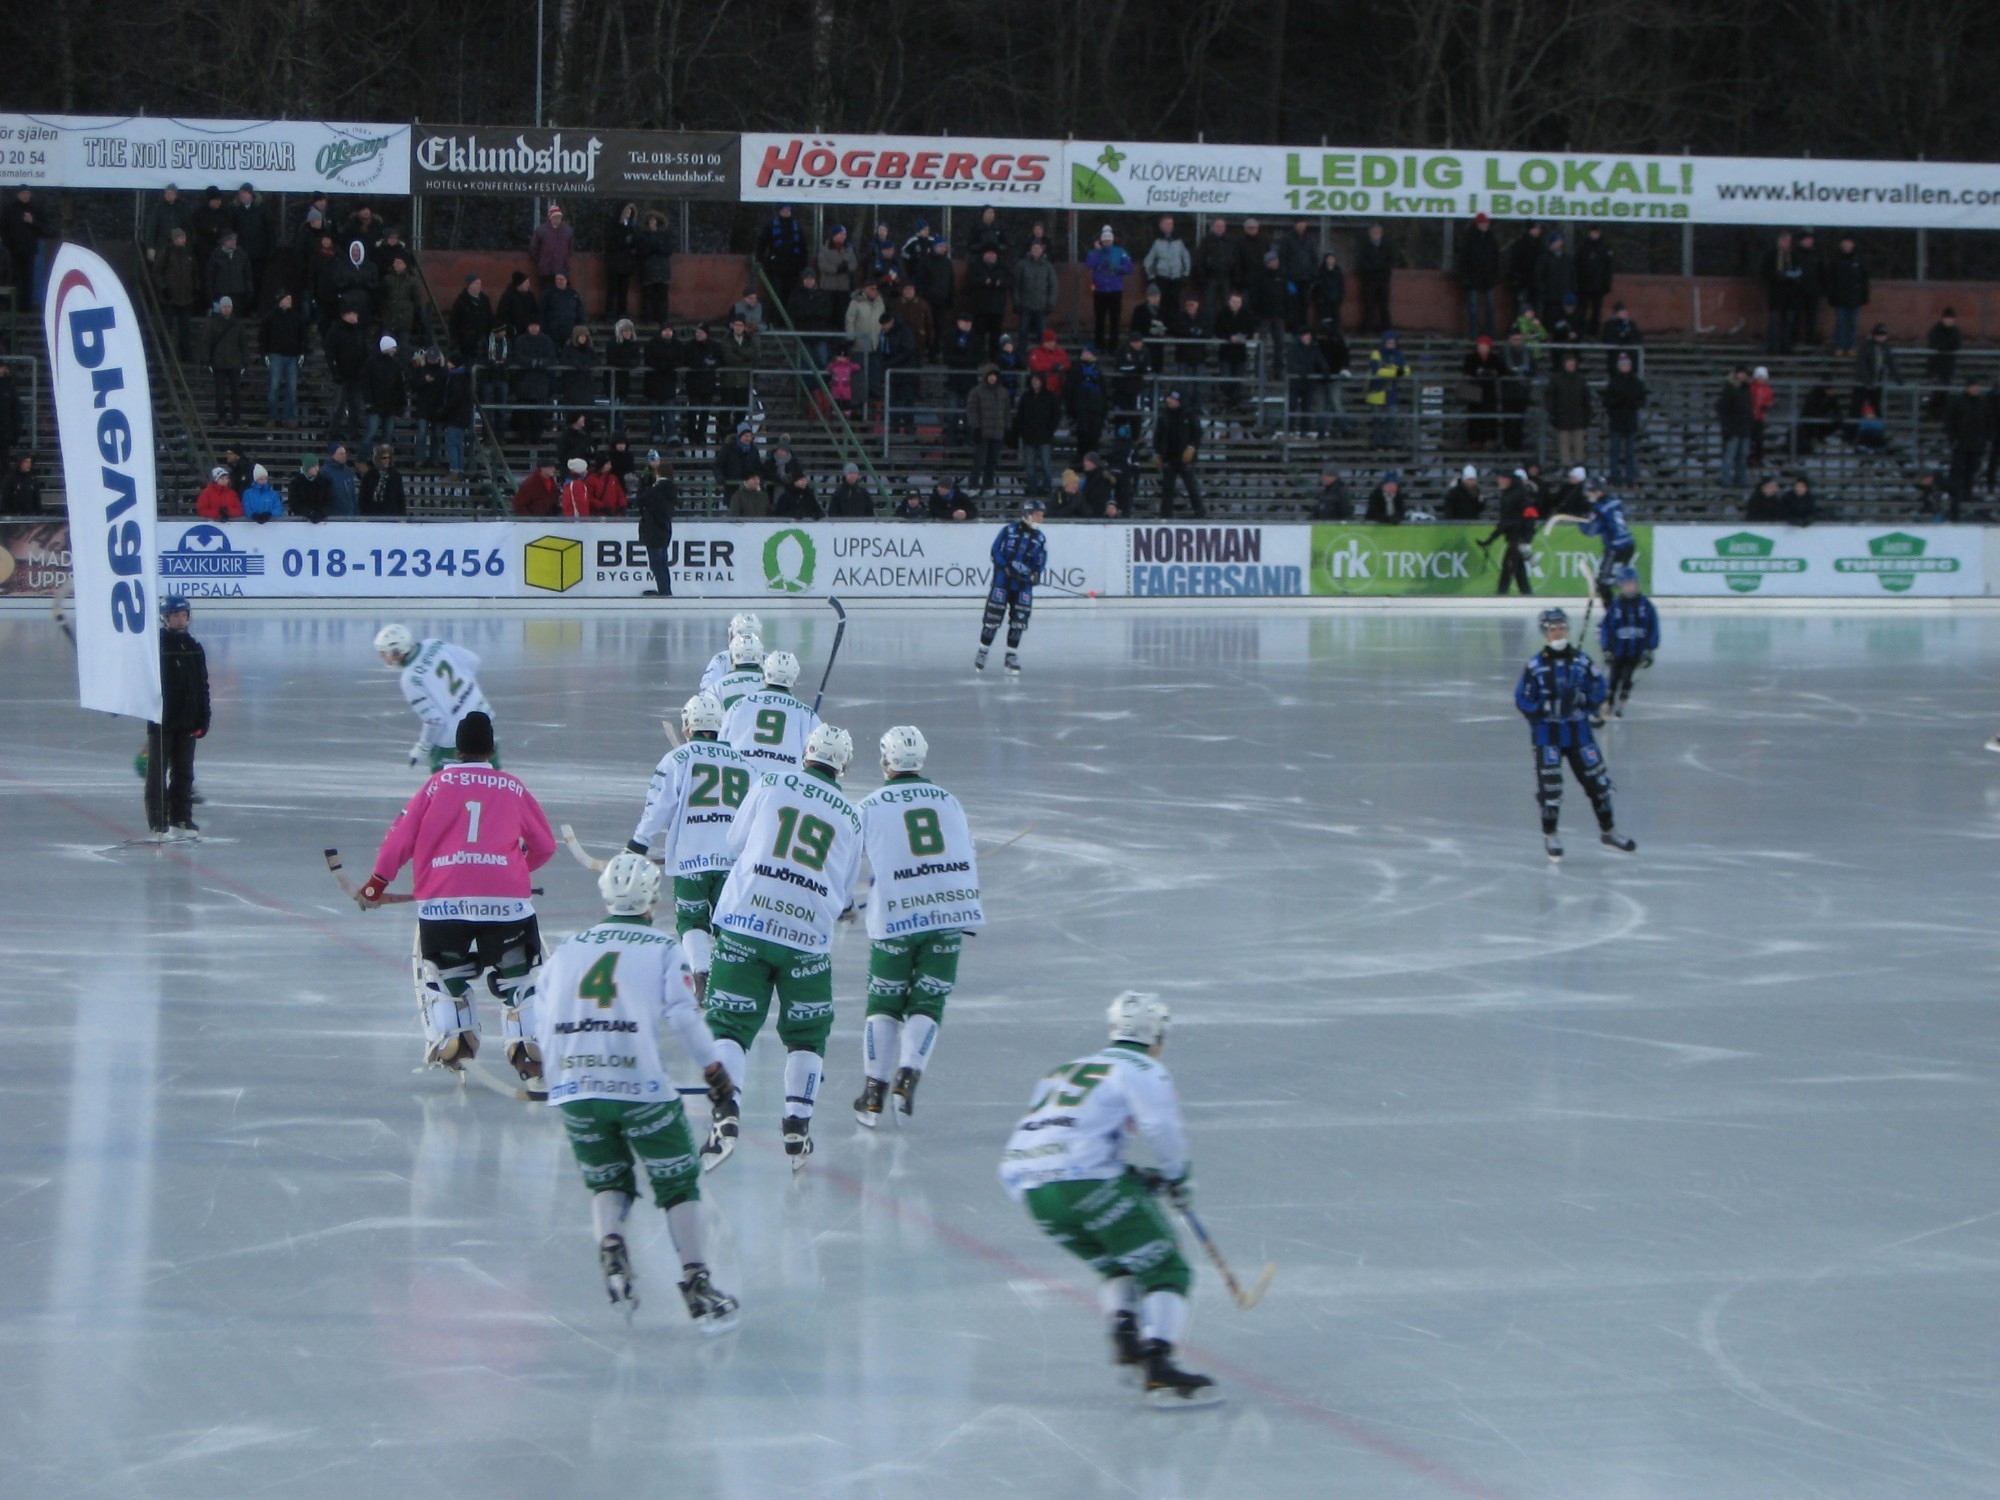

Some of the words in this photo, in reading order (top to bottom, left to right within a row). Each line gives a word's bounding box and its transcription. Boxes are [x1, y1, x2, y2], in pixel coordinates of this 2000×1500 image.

[17, 127, 59, 143] själen
[9, 150, 25, 164] 20
[30, 151, 46, 165] 54
[84, 137, 127, 168] THE
[171, 140, 296, 172] SPORTSBAR
[416, 132, 604, 182] Eklundshof
[628, 151, 649, 164] Tel.
[651, 152, 688, 165] 018-55
[690, 153, 704, 165] 01
[707, 154, 721, 165] 00
[756, 139, 1049, 188] HÖGBERGS
[623, 170, 726, 183] www.eklundshof.se
[1129, 160, 1262, 183] KLÖVERVALLEN
[1286, 153, 1463, 189] LEDIG
[1486, 158, 1694, 195] LOKAL!
[425, 180, 463, 190] HOTELL
[470, 181, 528, 192] KONFERENS
[534, 181, 595, 193] FESTVÅNING
[776, 177, 852, 189] BUSS
[862, 180, 902, 191] AB
[913, 181, 1041, 193] UPPSALA
[1146, 185, 1230, 206] fastigheter
[1285, 189, 1371, 211] 1200
[1383, 191, 1455, 214] kvm
[1490, 193, 1689, 219] Boländerna
[596, 540, 735, 567] BEJER
[833, 537, 925, 558] UPPSALA
[1133, 527, 1262, 564] NORMAN
[166, 557, 243, 573] TAXIKURIR
[282, 548, 505, 577] 018-123456
[1332, 539, 1371, 579] rk
[1382, 551, 1471, 579] TRYCK
[1556, 551, 1641, 579] TRY
[596, 571, 735, 582] BYGGMTERIAL
[832, 563, 1086, 587] AKADEMIFÖRVING
[1133, 564, 1303, 596] FAGERSAND
[167, 582, 243, 597] UPPSALA
[435, 659, 464, 697] 2
[753, 709, 787, 746] 9
[440, 772, 525, 798] Q-gruppen
[688, 763, 750, 809] 28
[784, 774, 862, 835] Q-gruppen
[465, 800, 481, 843] 1
[686, 812, 735, 825] MILJÖTR
[771, 806, 836, 872] 19
[903, 807, 946, 857] 8
[432, 851, 508, 868] MILJÖTRANS
[893, 861, 970, 881] MILJÖTRANS
[753, 863, 828, 898] MILJÖTRANS
[421, 900, 510, 917] amfafinans
[751, 894, 815, 923] NILSSON
[887, 900, 897, 912] P
[724, 913, 817, 947] amfafinans
[885, 908, 982, 934] amfafinans
[578, 951, 622, 1009] 4
[709, 999, 757, 1012] NTM
[787, 1004, 833, 1019] NTM
[554, 1018, 639, 1035] MILJÖTRANS
[560, 1054, 636, 1070] STBLOM
